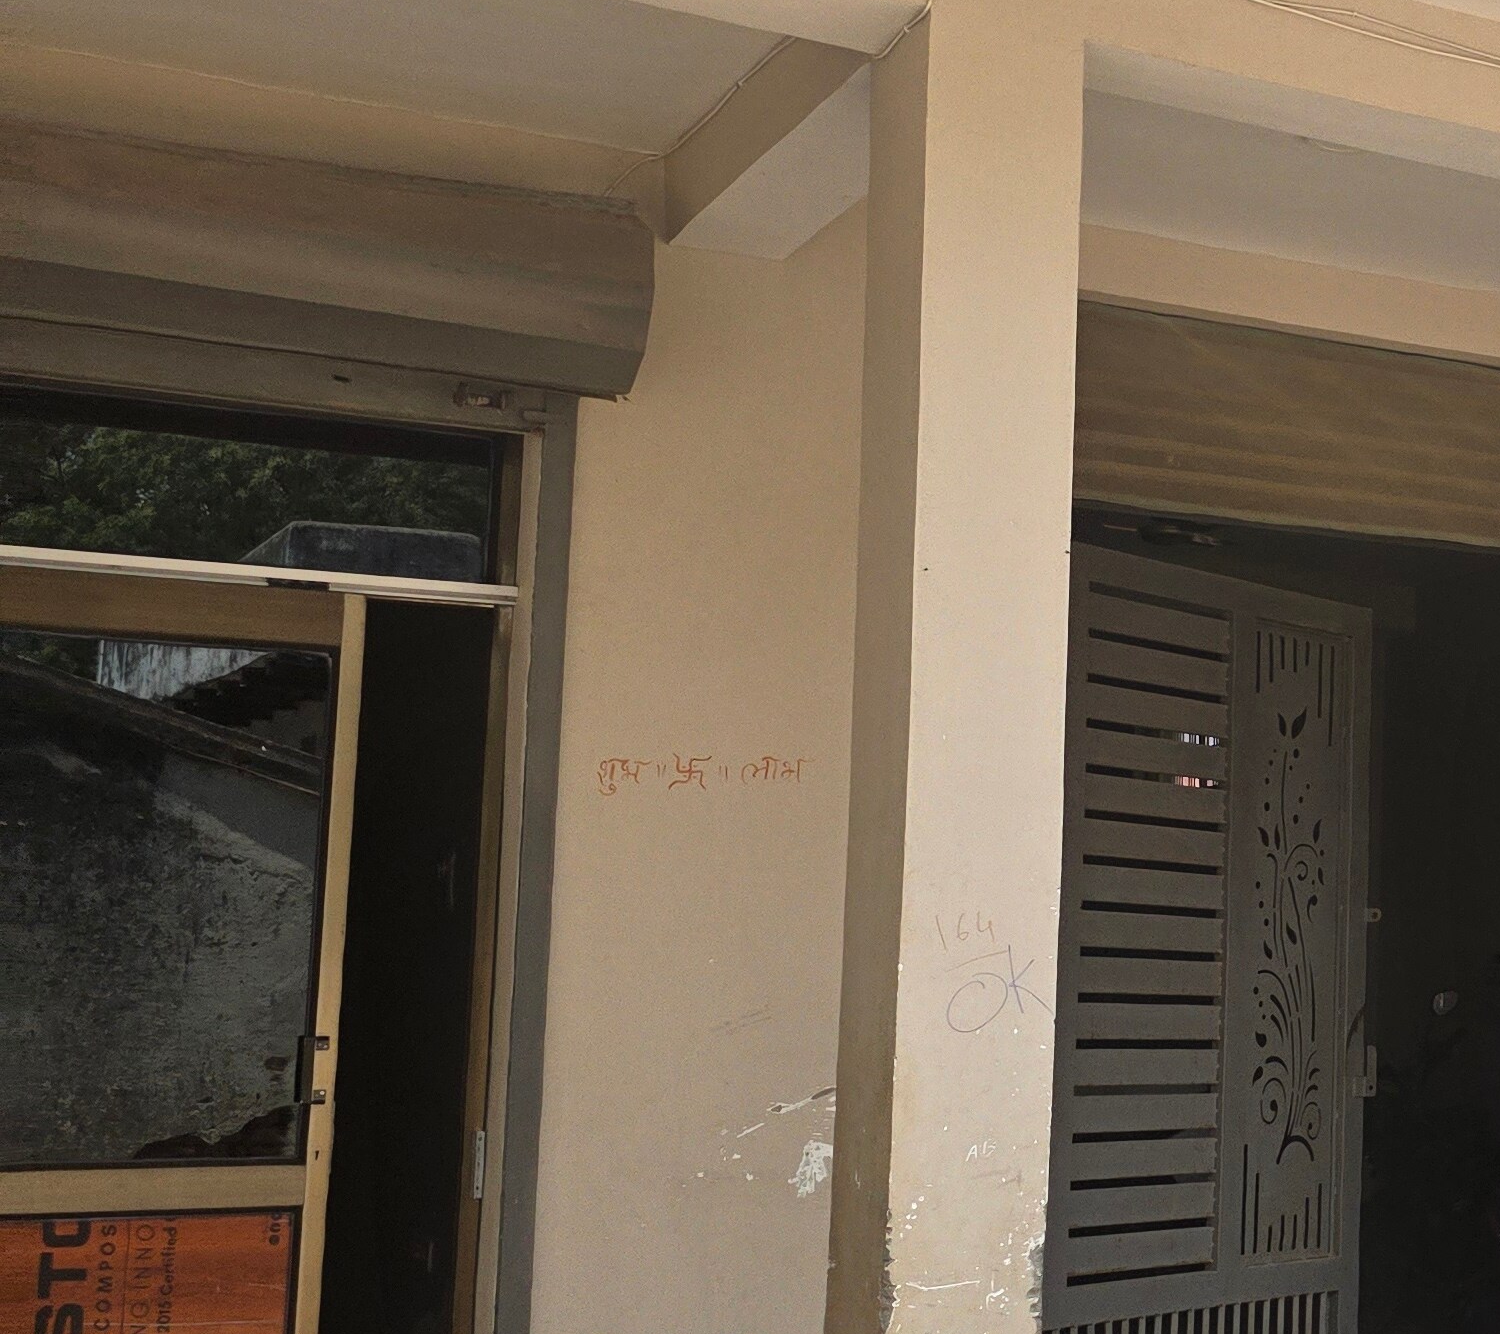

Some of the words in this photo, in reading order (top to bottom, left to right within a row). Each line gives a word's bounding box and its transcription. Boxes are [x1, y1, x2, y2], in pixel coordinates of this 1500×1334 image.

[946, 944, 1055, 1033] OK
[94, 1224, 117, 1332] COMPOS
[133, 1223, 156, 1290] INNO
